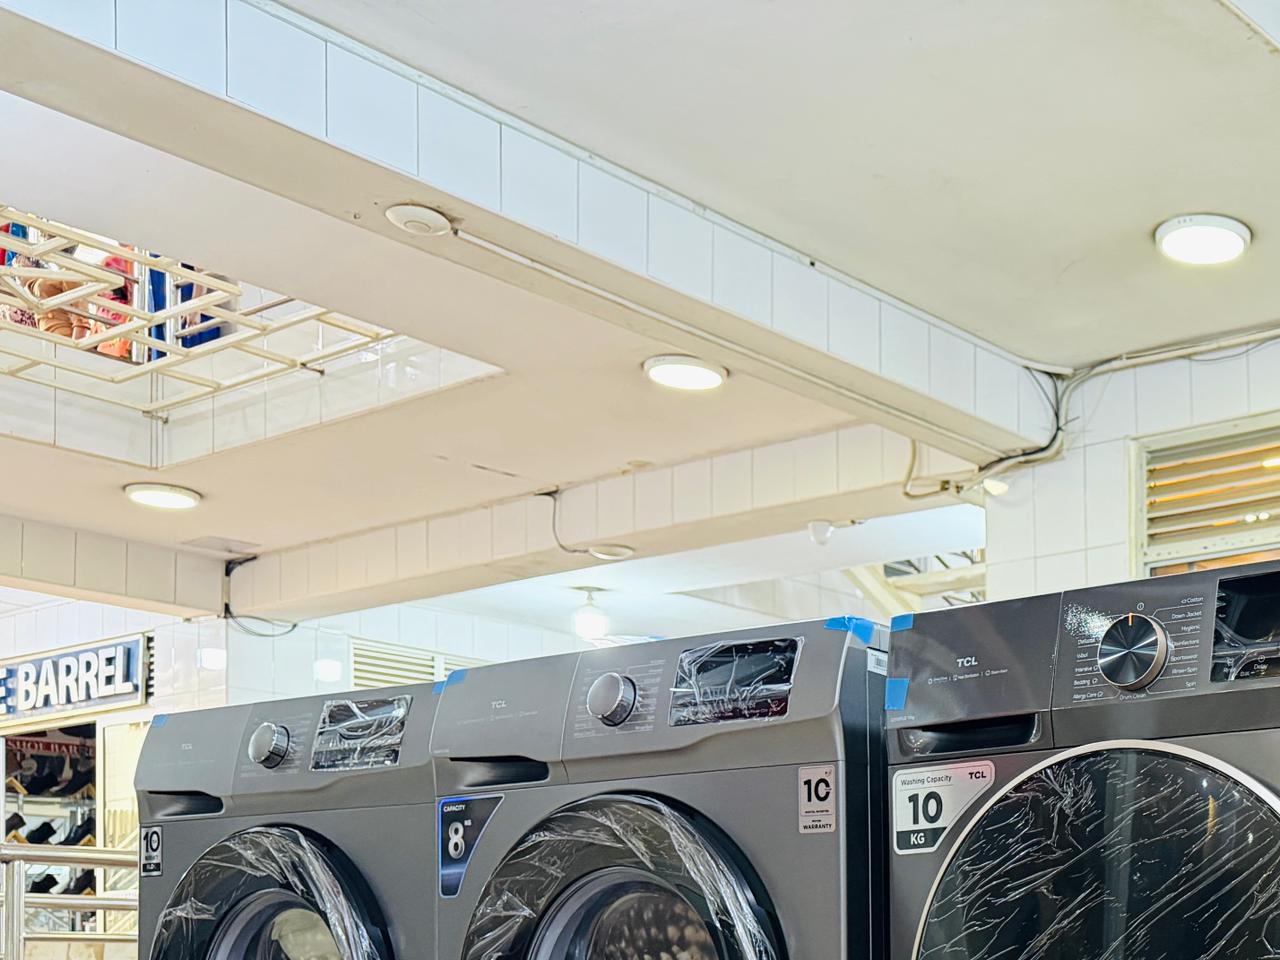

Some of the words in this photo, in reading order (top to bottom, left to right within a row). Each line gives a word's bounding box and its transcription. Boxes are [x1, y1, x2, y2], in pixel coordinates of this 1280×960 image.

[957, 656, 979, 668] TCL
[17, 645, 134, 711] BARREL
[490, 700, 508, 709] TCL
[926, 775, 952, 784] Capacity
[968, 771, 987, 780] TCL
[908, 791, 943, 825] 10
[143, 830, 161, 853] 10
[448, 821, 465, 860] 8
[910, 832, 925, 845] KG
